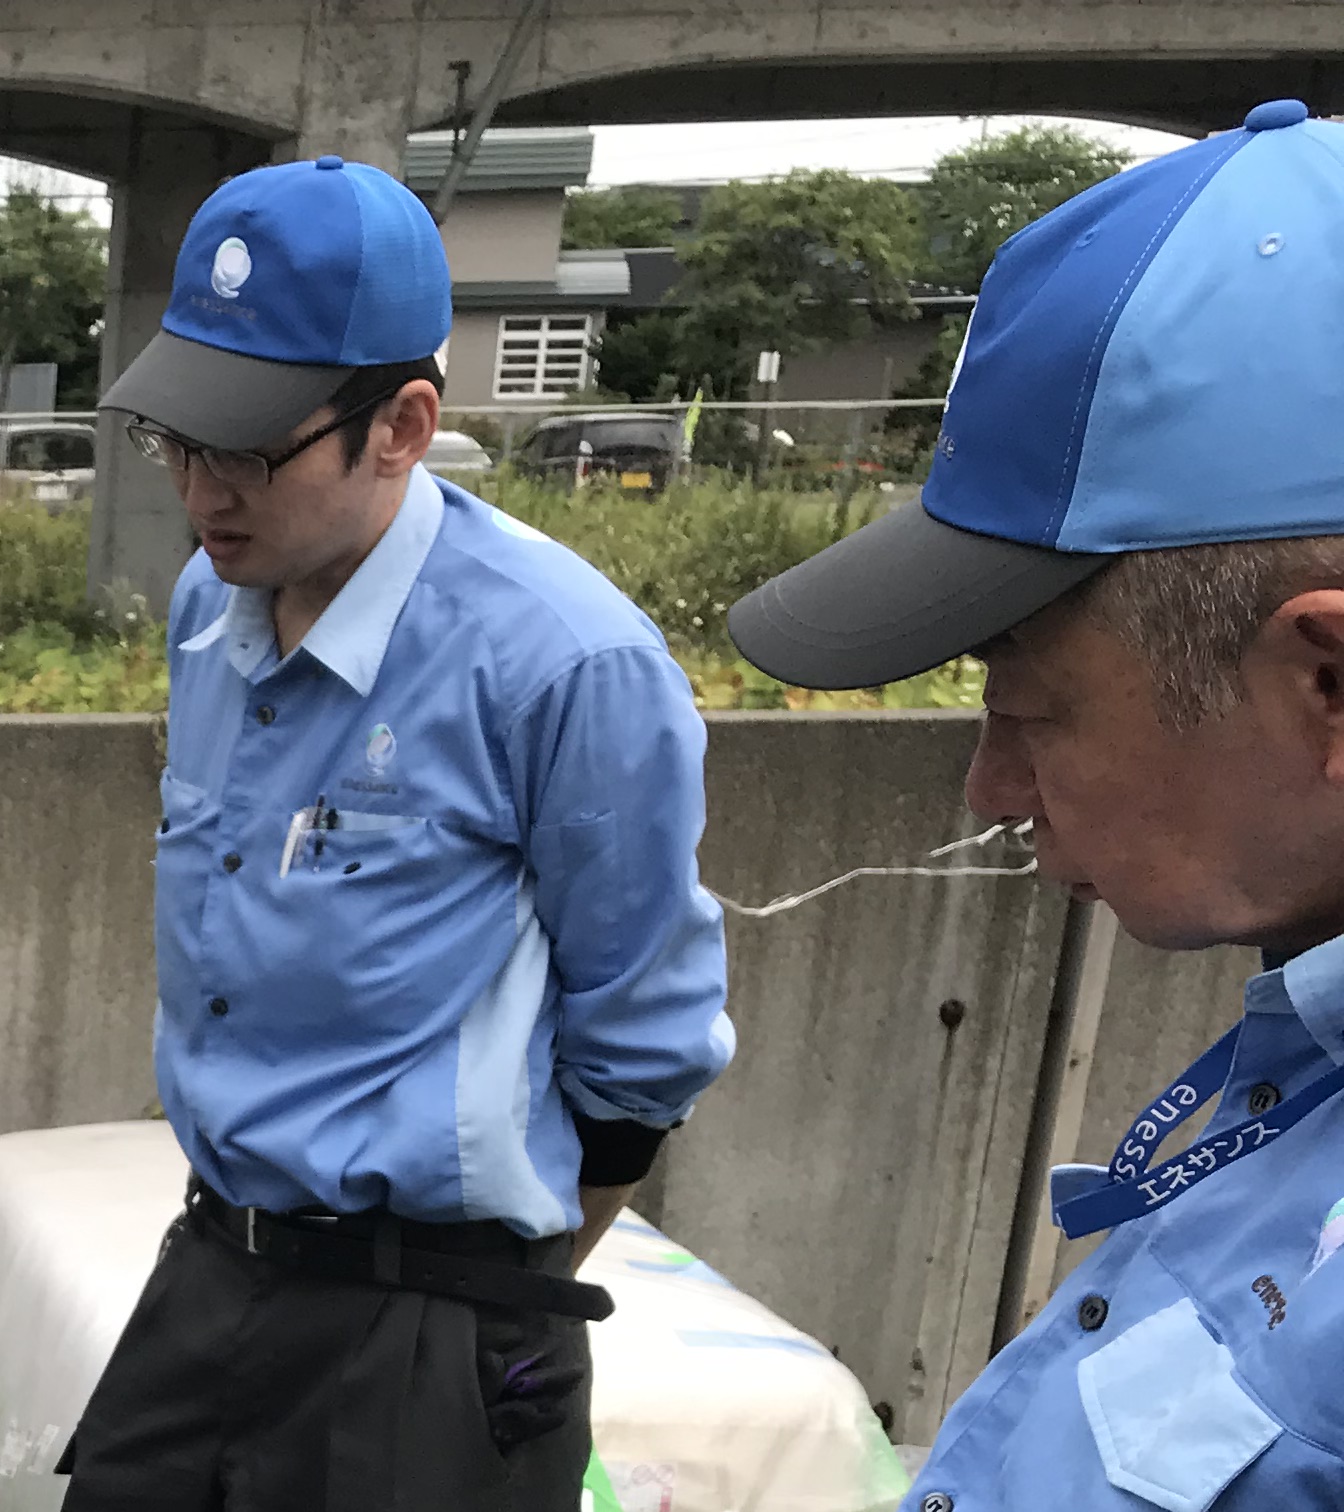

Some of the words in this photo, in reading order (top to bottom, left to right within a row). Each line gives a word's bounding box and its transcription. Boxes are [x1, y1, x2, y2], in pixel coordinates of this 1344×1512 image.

[1137, 1121, 1280, 1205] エネサンス
